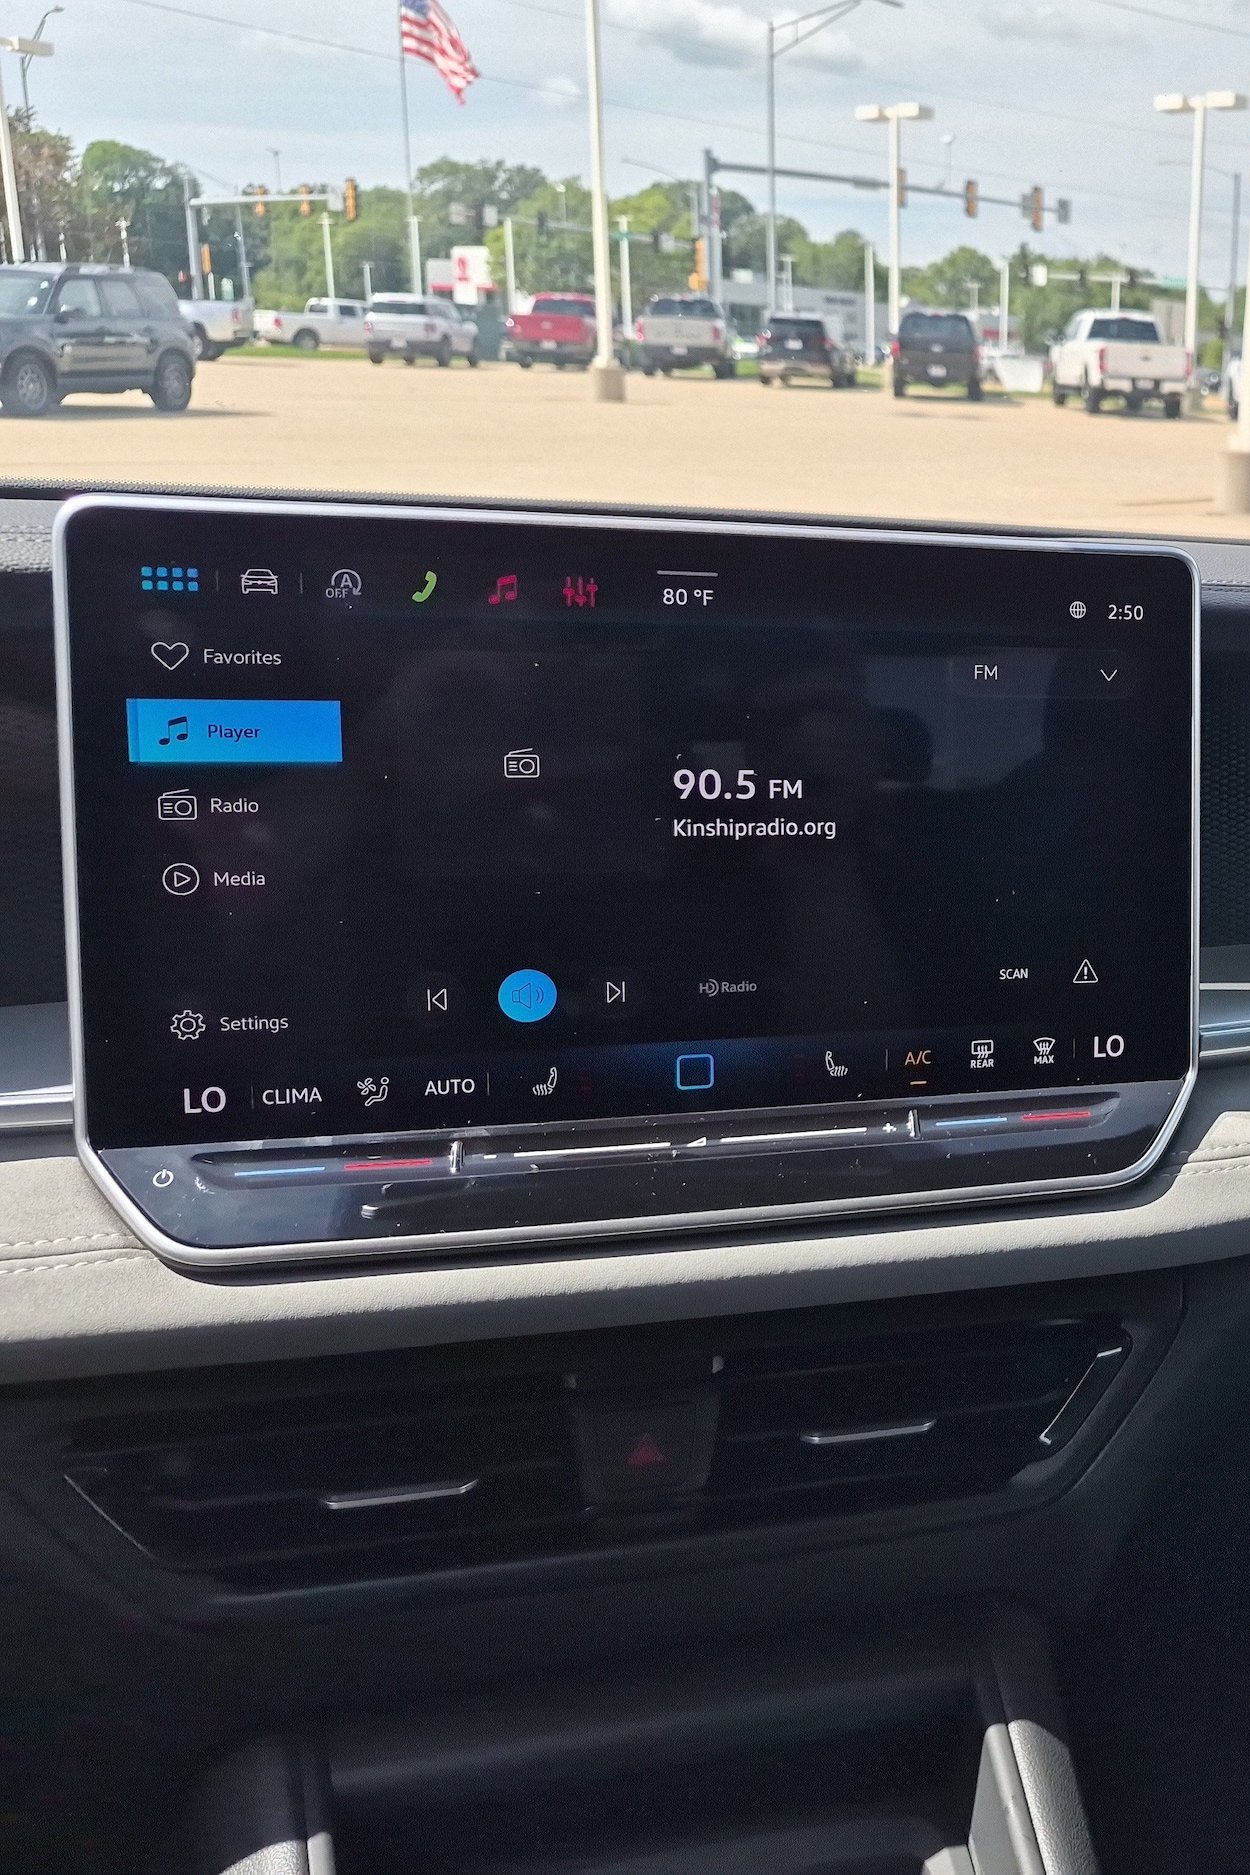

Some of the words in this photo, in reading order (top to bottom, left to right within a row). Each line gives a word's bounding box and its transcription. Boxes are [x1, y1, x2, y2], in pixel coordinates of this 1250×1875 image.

[325, 587, 349, 599] OFF
[662, 588, 688, 606] 80
[693, 589, 714, 606] °F
[1107, 604, 1144, 621] 2:50
[203, 648, 282, 665] Favorites
[974, 665, 999, 680] FM
[207, 724, 261, 741] Player
[673, 768, 757, 800] 90.5
[769, 779, 803, 799] FM
[210, 797, 259, 813] Radio
[673, 817, 836, 840] Kinshipradio.org
[213, 870, 266, 887] Media
[999, 968, 1029, 980] SCAN
[721, 980, 757, 993] Radio
[219, 1015, 289, 1034] Settings
[1093, 1034, 1125, 1058] LO
[904, 1049, 932, 1066] A/C
[970, 1059, 994, 1069] REAR
[1033, 1055, 1055, 1065] MAX
[424, 1078, 475, 1096] AUTO
[183, 1086, 227, 1114] LO
[262, 1087, 323, 1105] CLIMA
